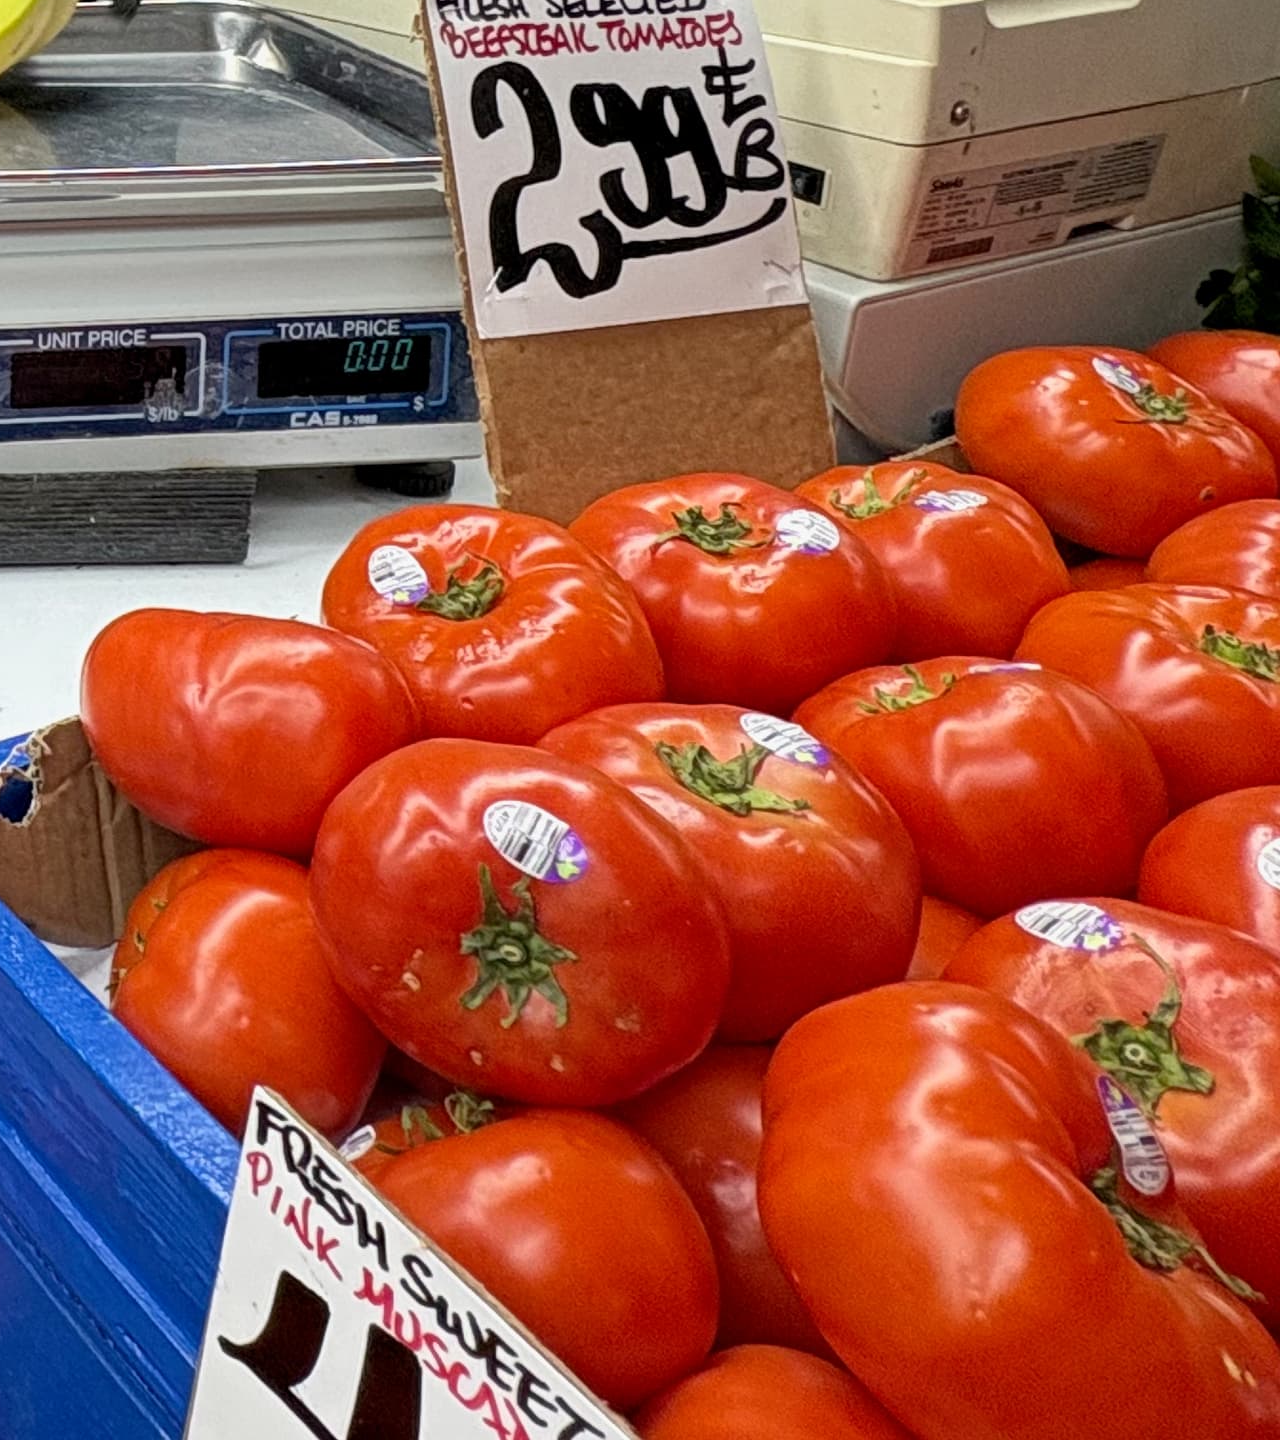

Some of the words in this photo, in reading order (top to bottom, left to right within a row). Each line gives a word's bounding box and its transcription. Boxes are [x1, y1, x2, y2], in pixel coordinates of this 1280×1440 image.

[597, 8, 744, 53] TOMATOES
[38, 330, 85, 350] UNIT
[87, 327, 148, 349] PRICE
[276, 321, 340, 340] TOTAL
[342, 318, 401, 338] PRICE
[412, 395, 426, 412] $
[289, 410, 341, 429] CAS
[244, 1150, 345, 1282] PINK
[398, 1252, 607, 1440] SWEET
